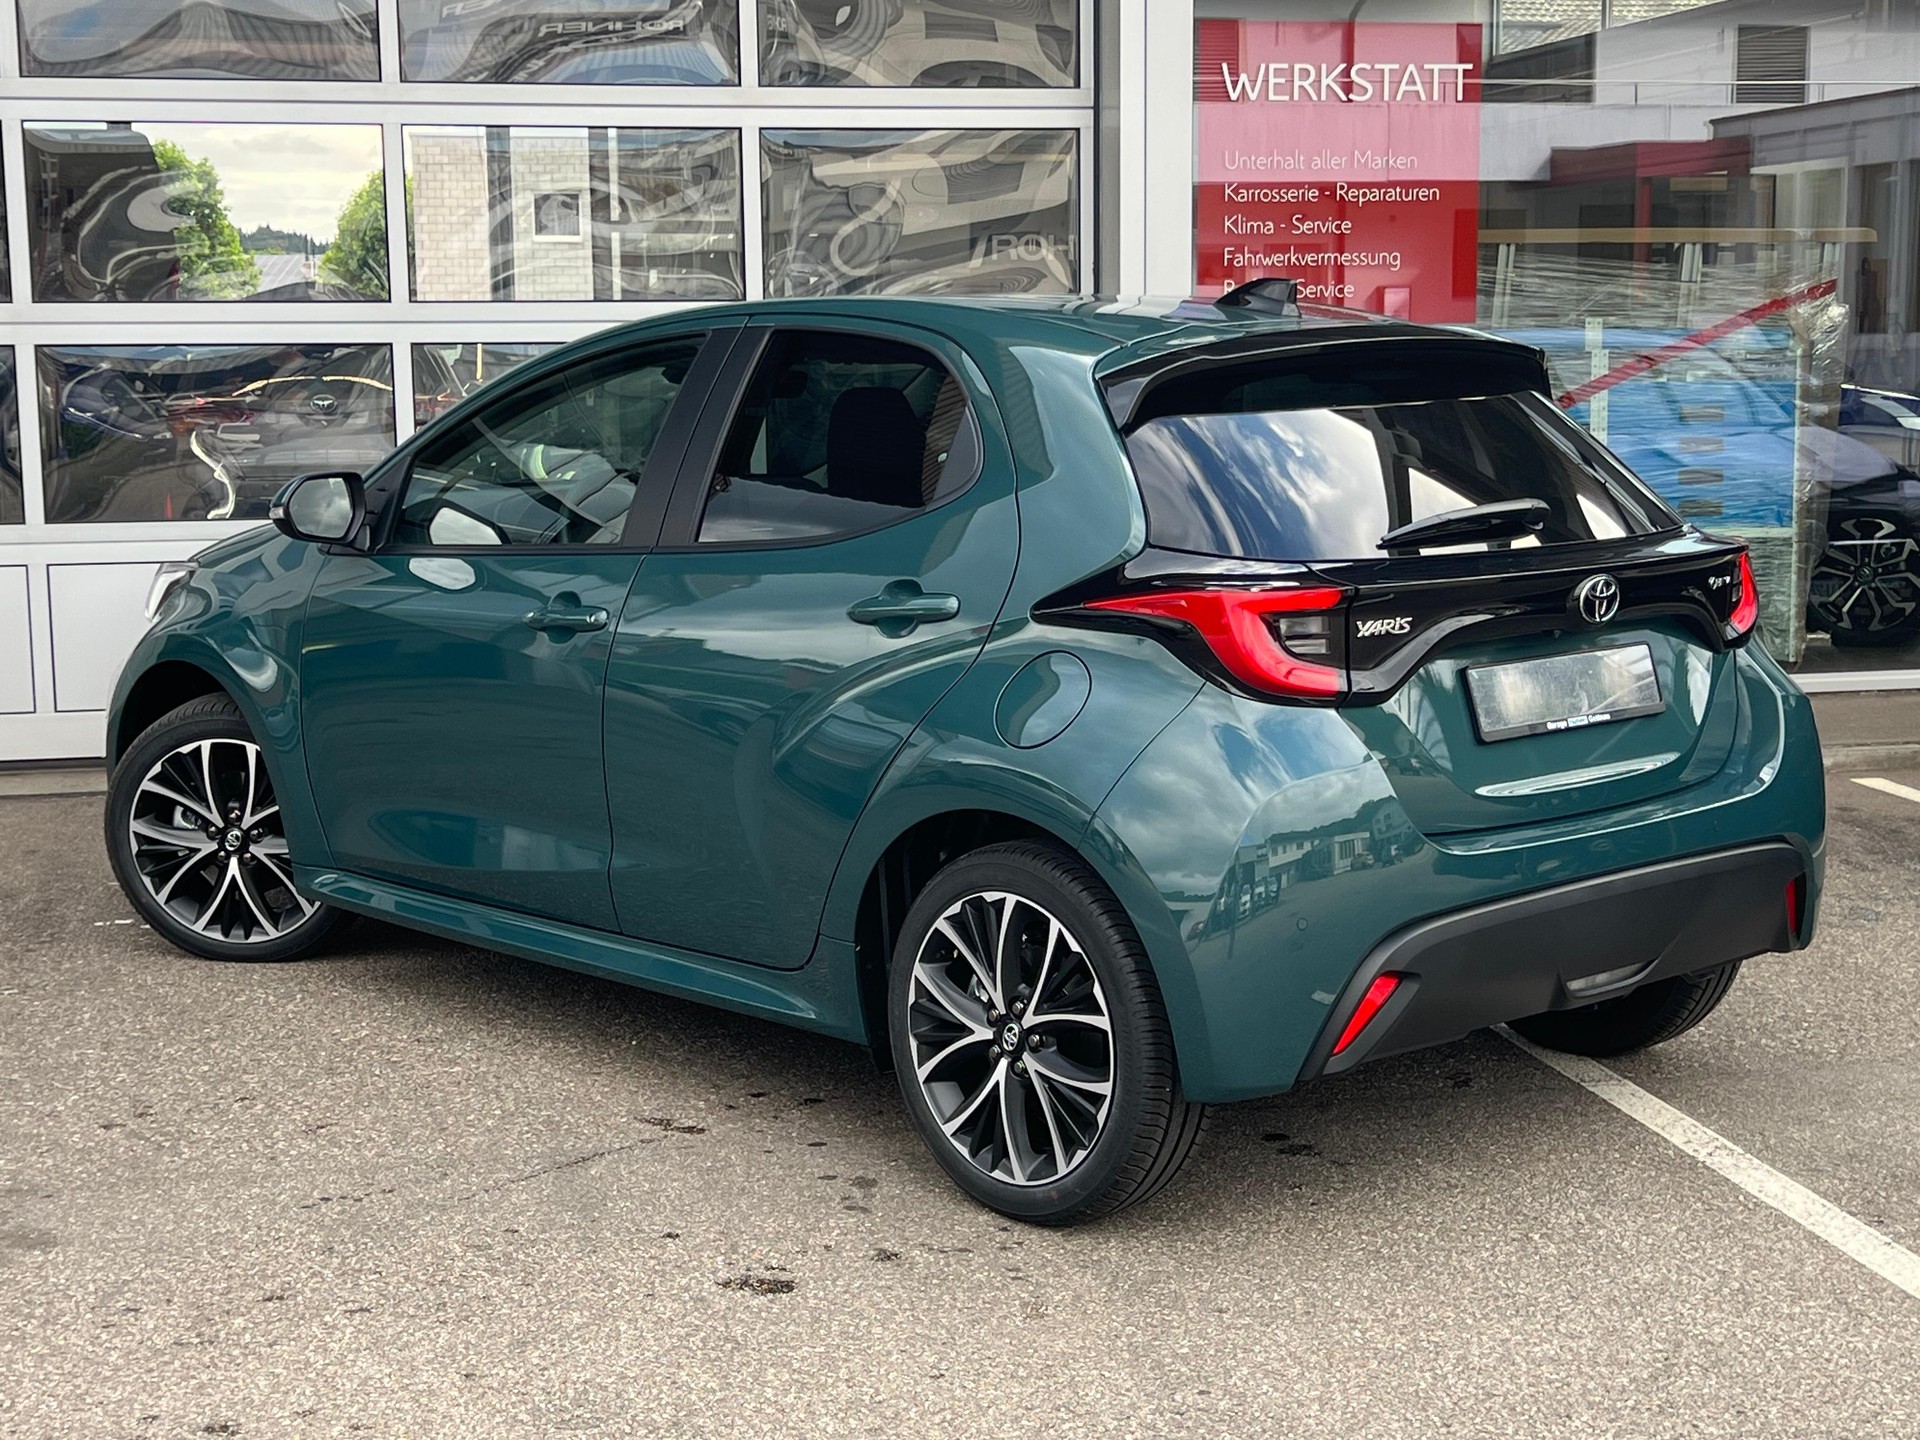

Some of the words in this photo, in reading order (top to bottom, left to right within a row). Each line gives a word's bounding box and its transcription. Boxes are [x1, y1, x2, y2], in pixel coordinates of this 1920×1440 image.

[1221, 62, 1474, 102] WERKSTATT
[1224, 150, 1305, 170] Unterhalt
[1311, 150, 1348, 170] aller
[1354, 150, 1418, 170] Marken
[1224, 182, 1319, 203] Karrosserie
[1336, 182, 1440, 207] Reparaturen
[1224, 215, 1274, 235] Klima
[1291, 215, 1352, 235] Service
[1223, 247, 1401, 271] Fahrwerkvermessung
[1296, 278, 1355, 298] Service
[1355, 616, 1413, 638] YARIS
